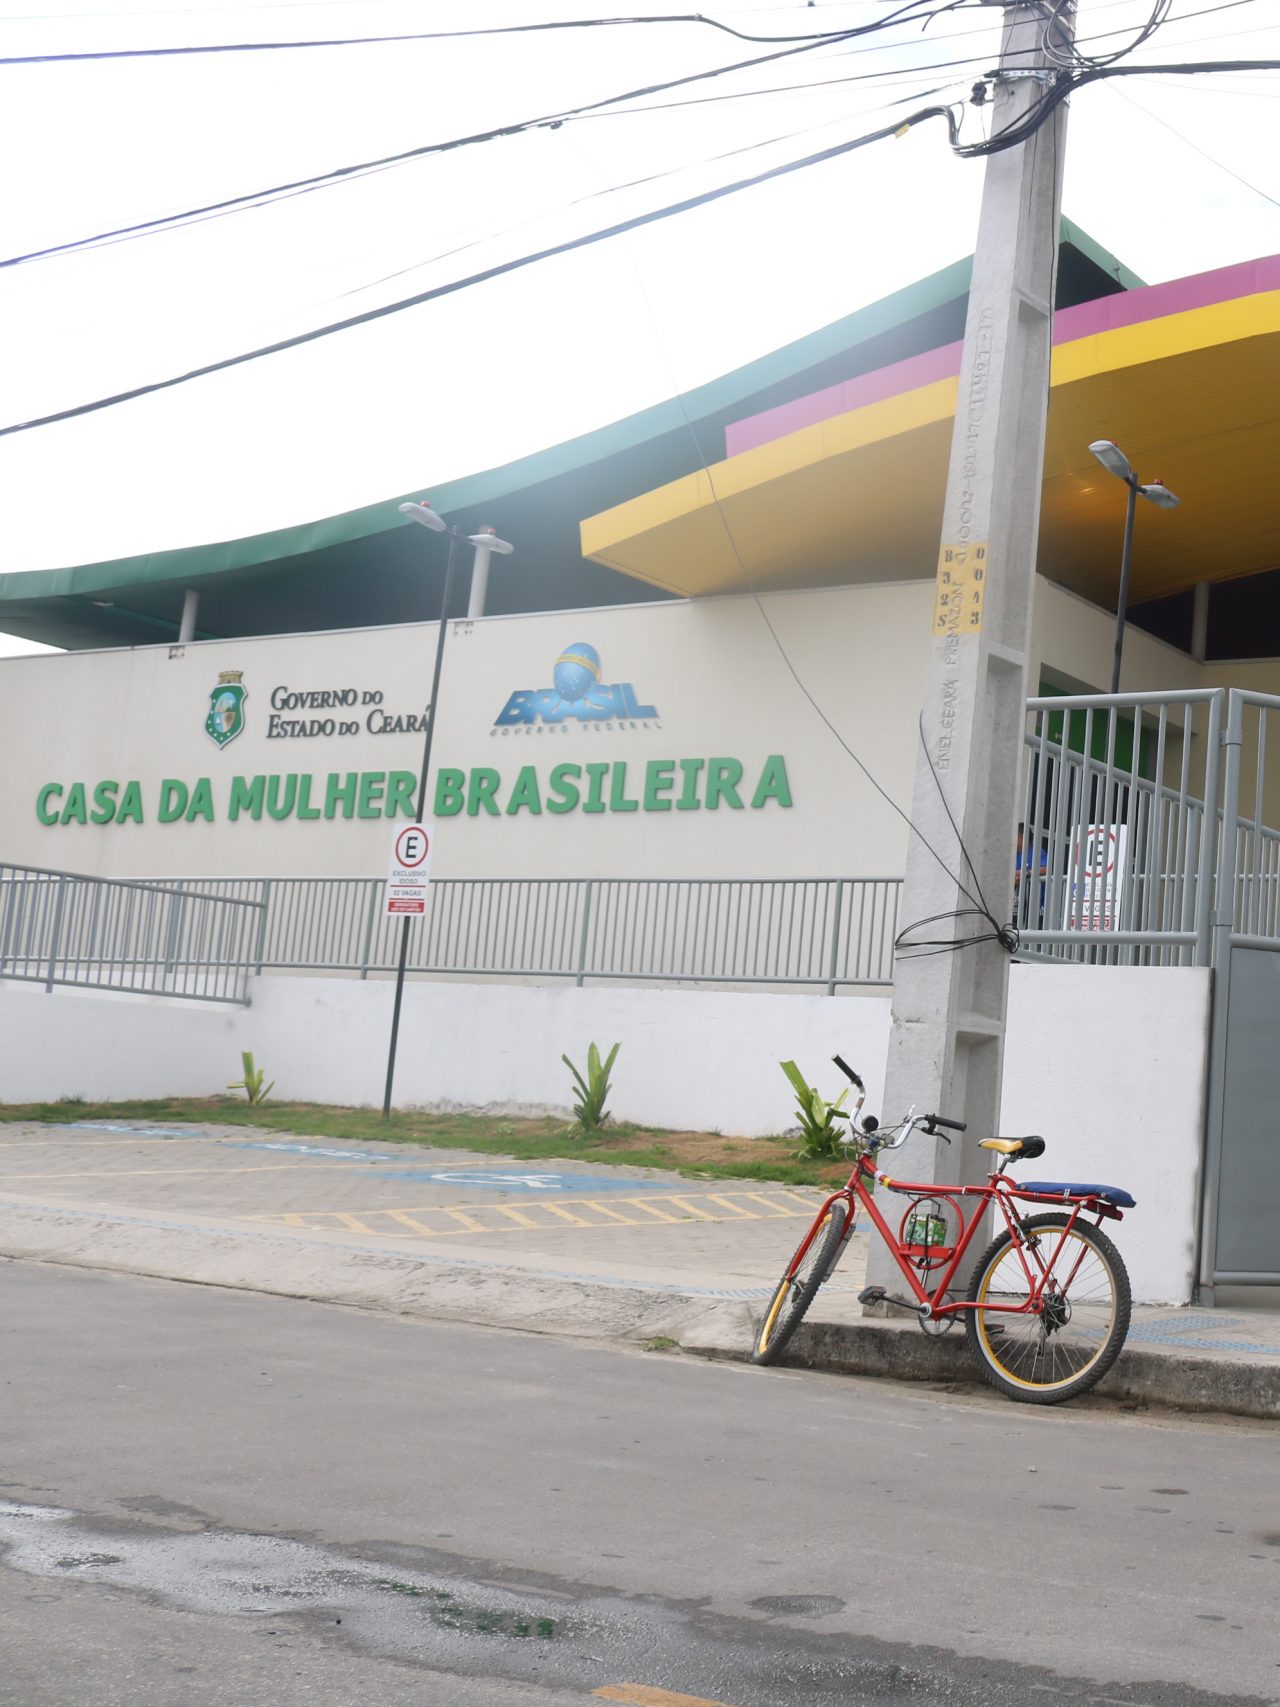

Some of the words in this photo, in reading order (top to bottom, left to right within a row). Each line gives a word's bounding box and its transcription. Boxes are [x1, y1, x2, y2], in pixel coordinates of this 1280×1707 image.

[270, 686, 358, 711] GOVERNO
[361, 690, 384, 705] DO
[266, 714, 336, 739] ESTADO
[338, 720, 360, 735] DO
[490, 725, 569, 738] GOVERNO
[582, 721, 663, 733] FEDERAL
[36, 780, 144, 827] CASA
[157, 777, 215, 823] DA
[227, 771, 418, 821] MULHER
[433, 754, 794, 817] BRASILEIRA
[405, 836, 419, 858] E
